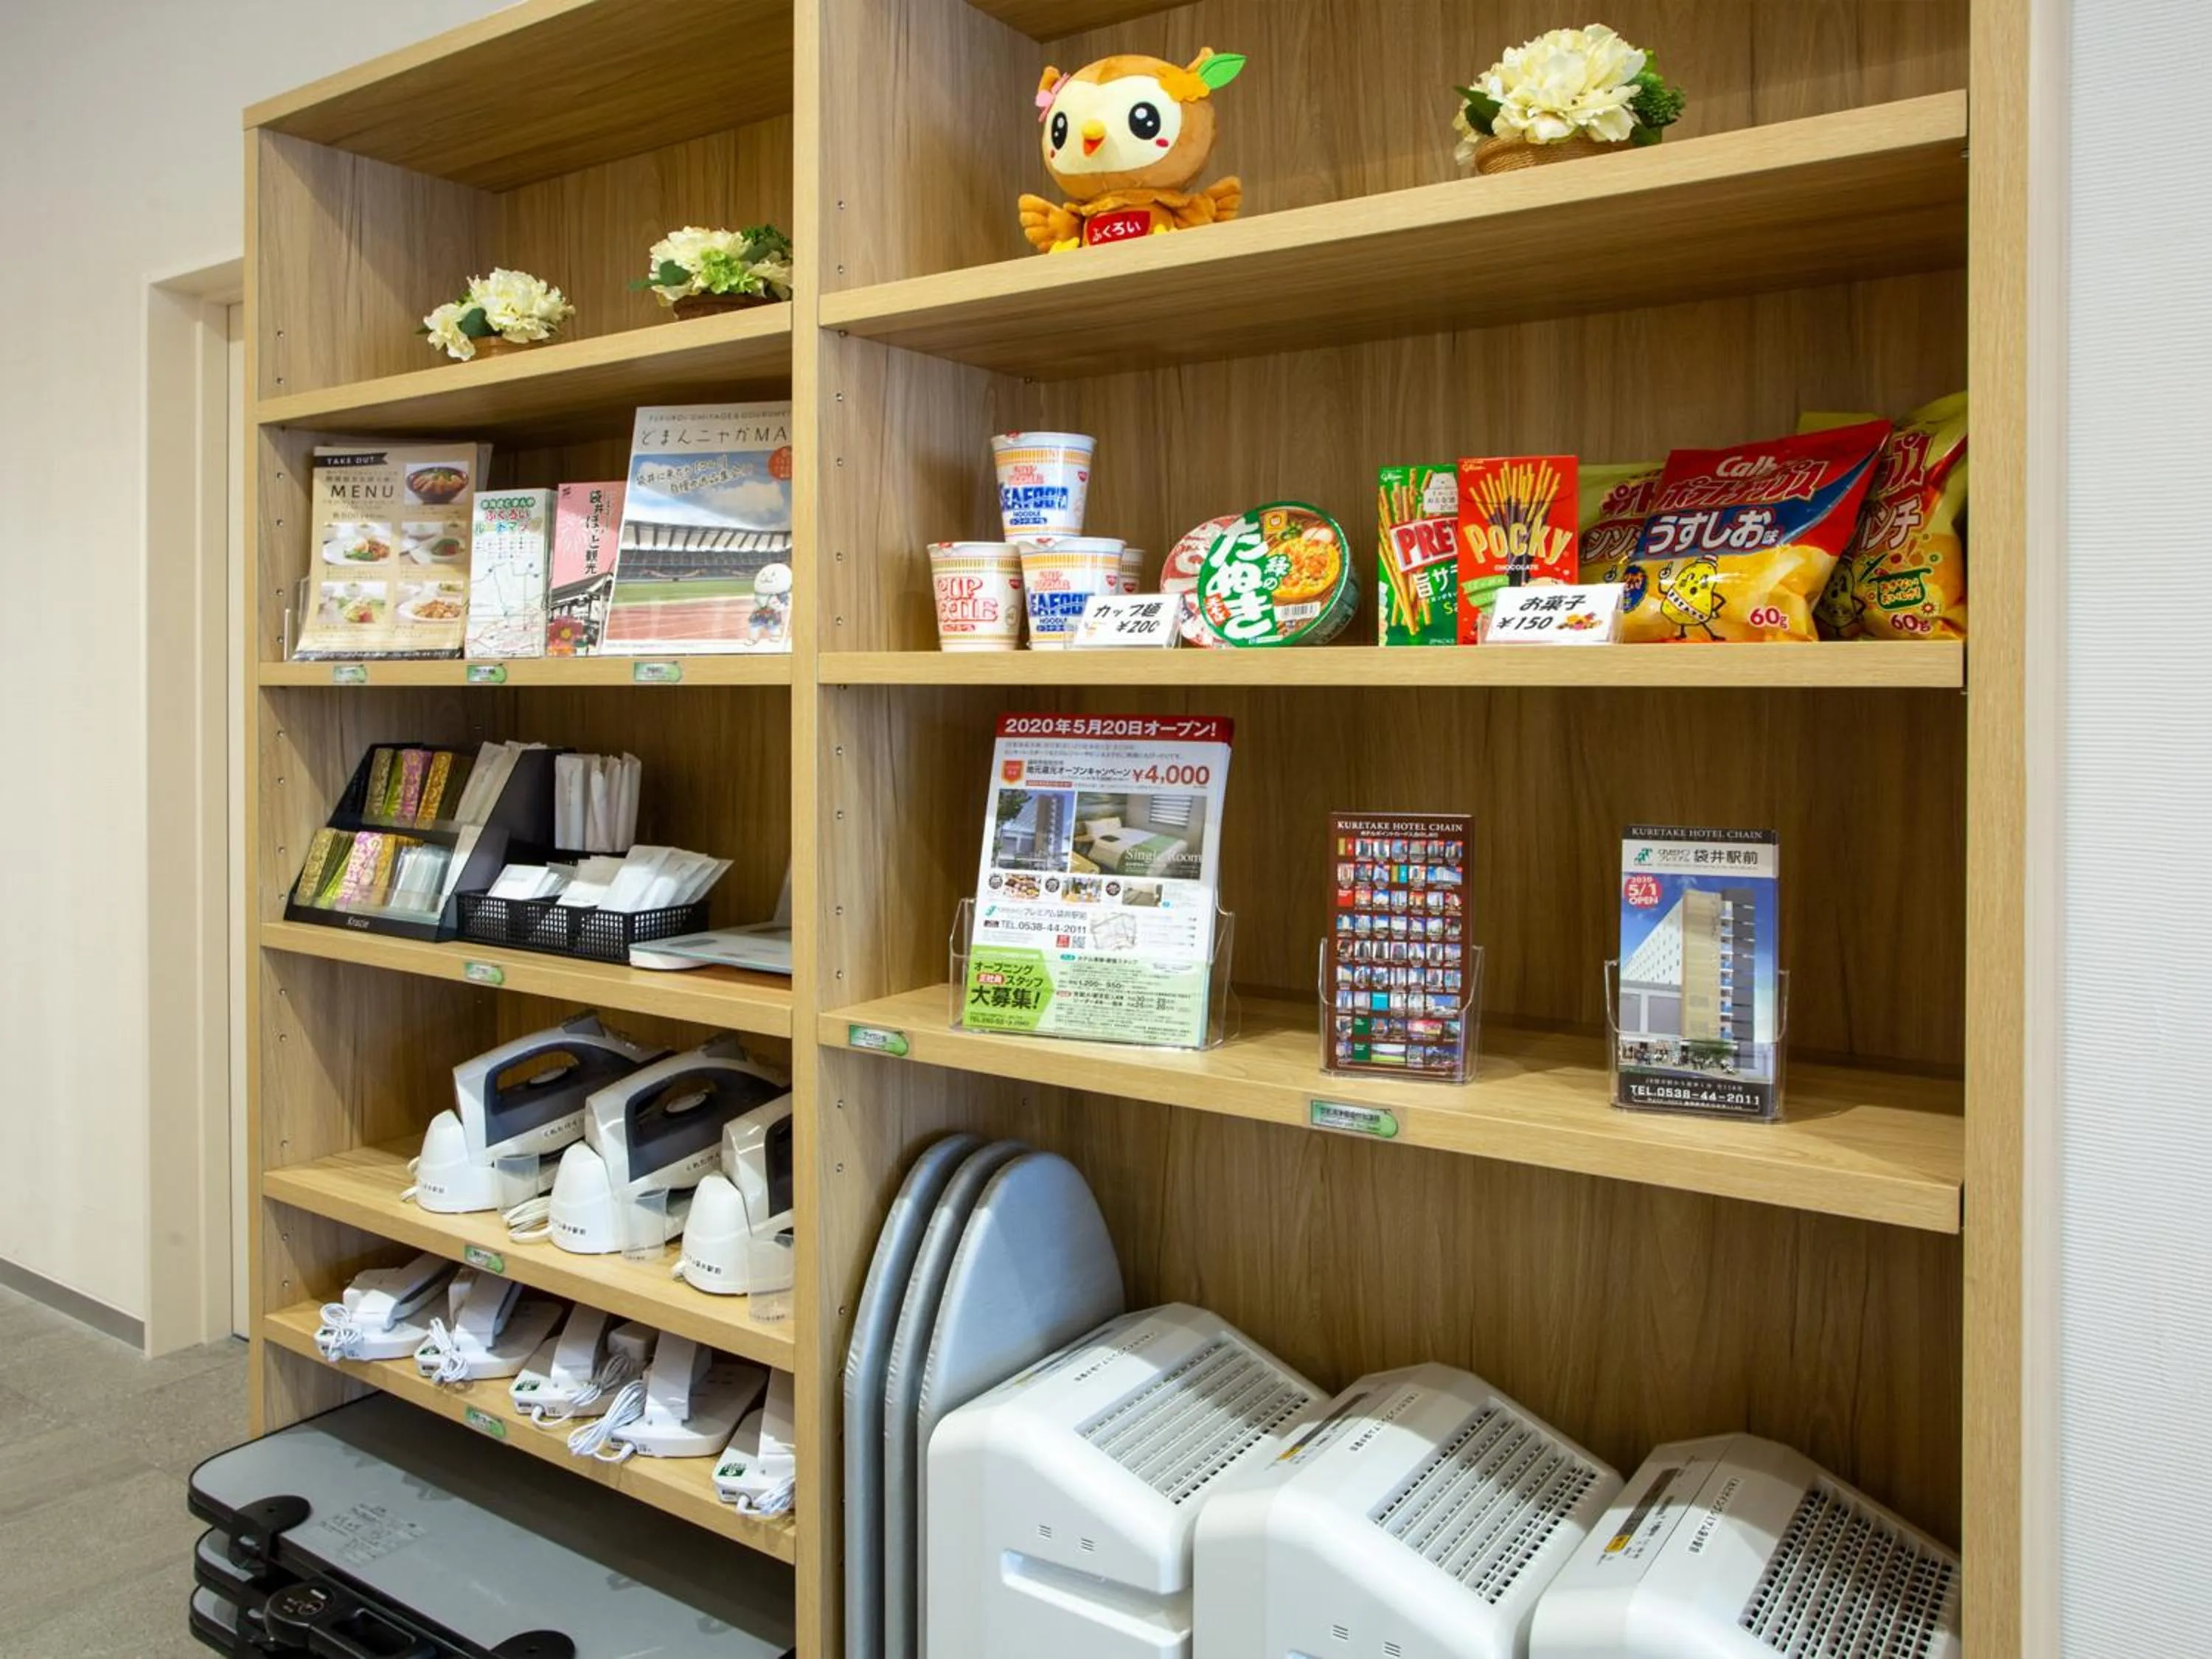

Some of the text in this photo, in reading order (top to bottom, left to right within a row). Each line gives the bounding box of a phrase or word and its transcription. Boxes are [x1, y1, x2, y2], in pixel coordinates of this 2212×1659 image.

[1092, 222, 1141, 243] ふくろい
[330, 484, 394, 498] MENU
[1463, 513, 1573, 566] POCKY
[1648, 509, 1779, 553] うすしお味
[1206, 516, 1273, 640] たぬき
[1029, 592, 1094, 616] EAFOO
[1519, 594, 1587, 611] お菓子
[1497, 616, 1554, 630] ¥150
[1750, 607, 1788, 629] 60g
[1891, 613, 1931, 633] 60g
[1004, 717, 1217, 737] 2020年5月20日オープン!
[1133, 765, 1210, 785] ¥4,000
[1337, 821, 1463, 832] KURETAKE HOTEL CHAIN
[1632, 827, 1763, 839] KURETAKE HOTEL CHAIN
[1694, 849, 1759, 865] 袋井駅前
[1628, 883, 1658, 897] 5/1
[1628, 896, 1659, 905] OPEN
[973, 961, 1034, 975] オープニング
[1006, 975, 1043, 987] スタッフ
[970, 985, 1041, 1009] 大募集!
[1630, 1085, 1760, 1105] TEL.0538-44-2011
